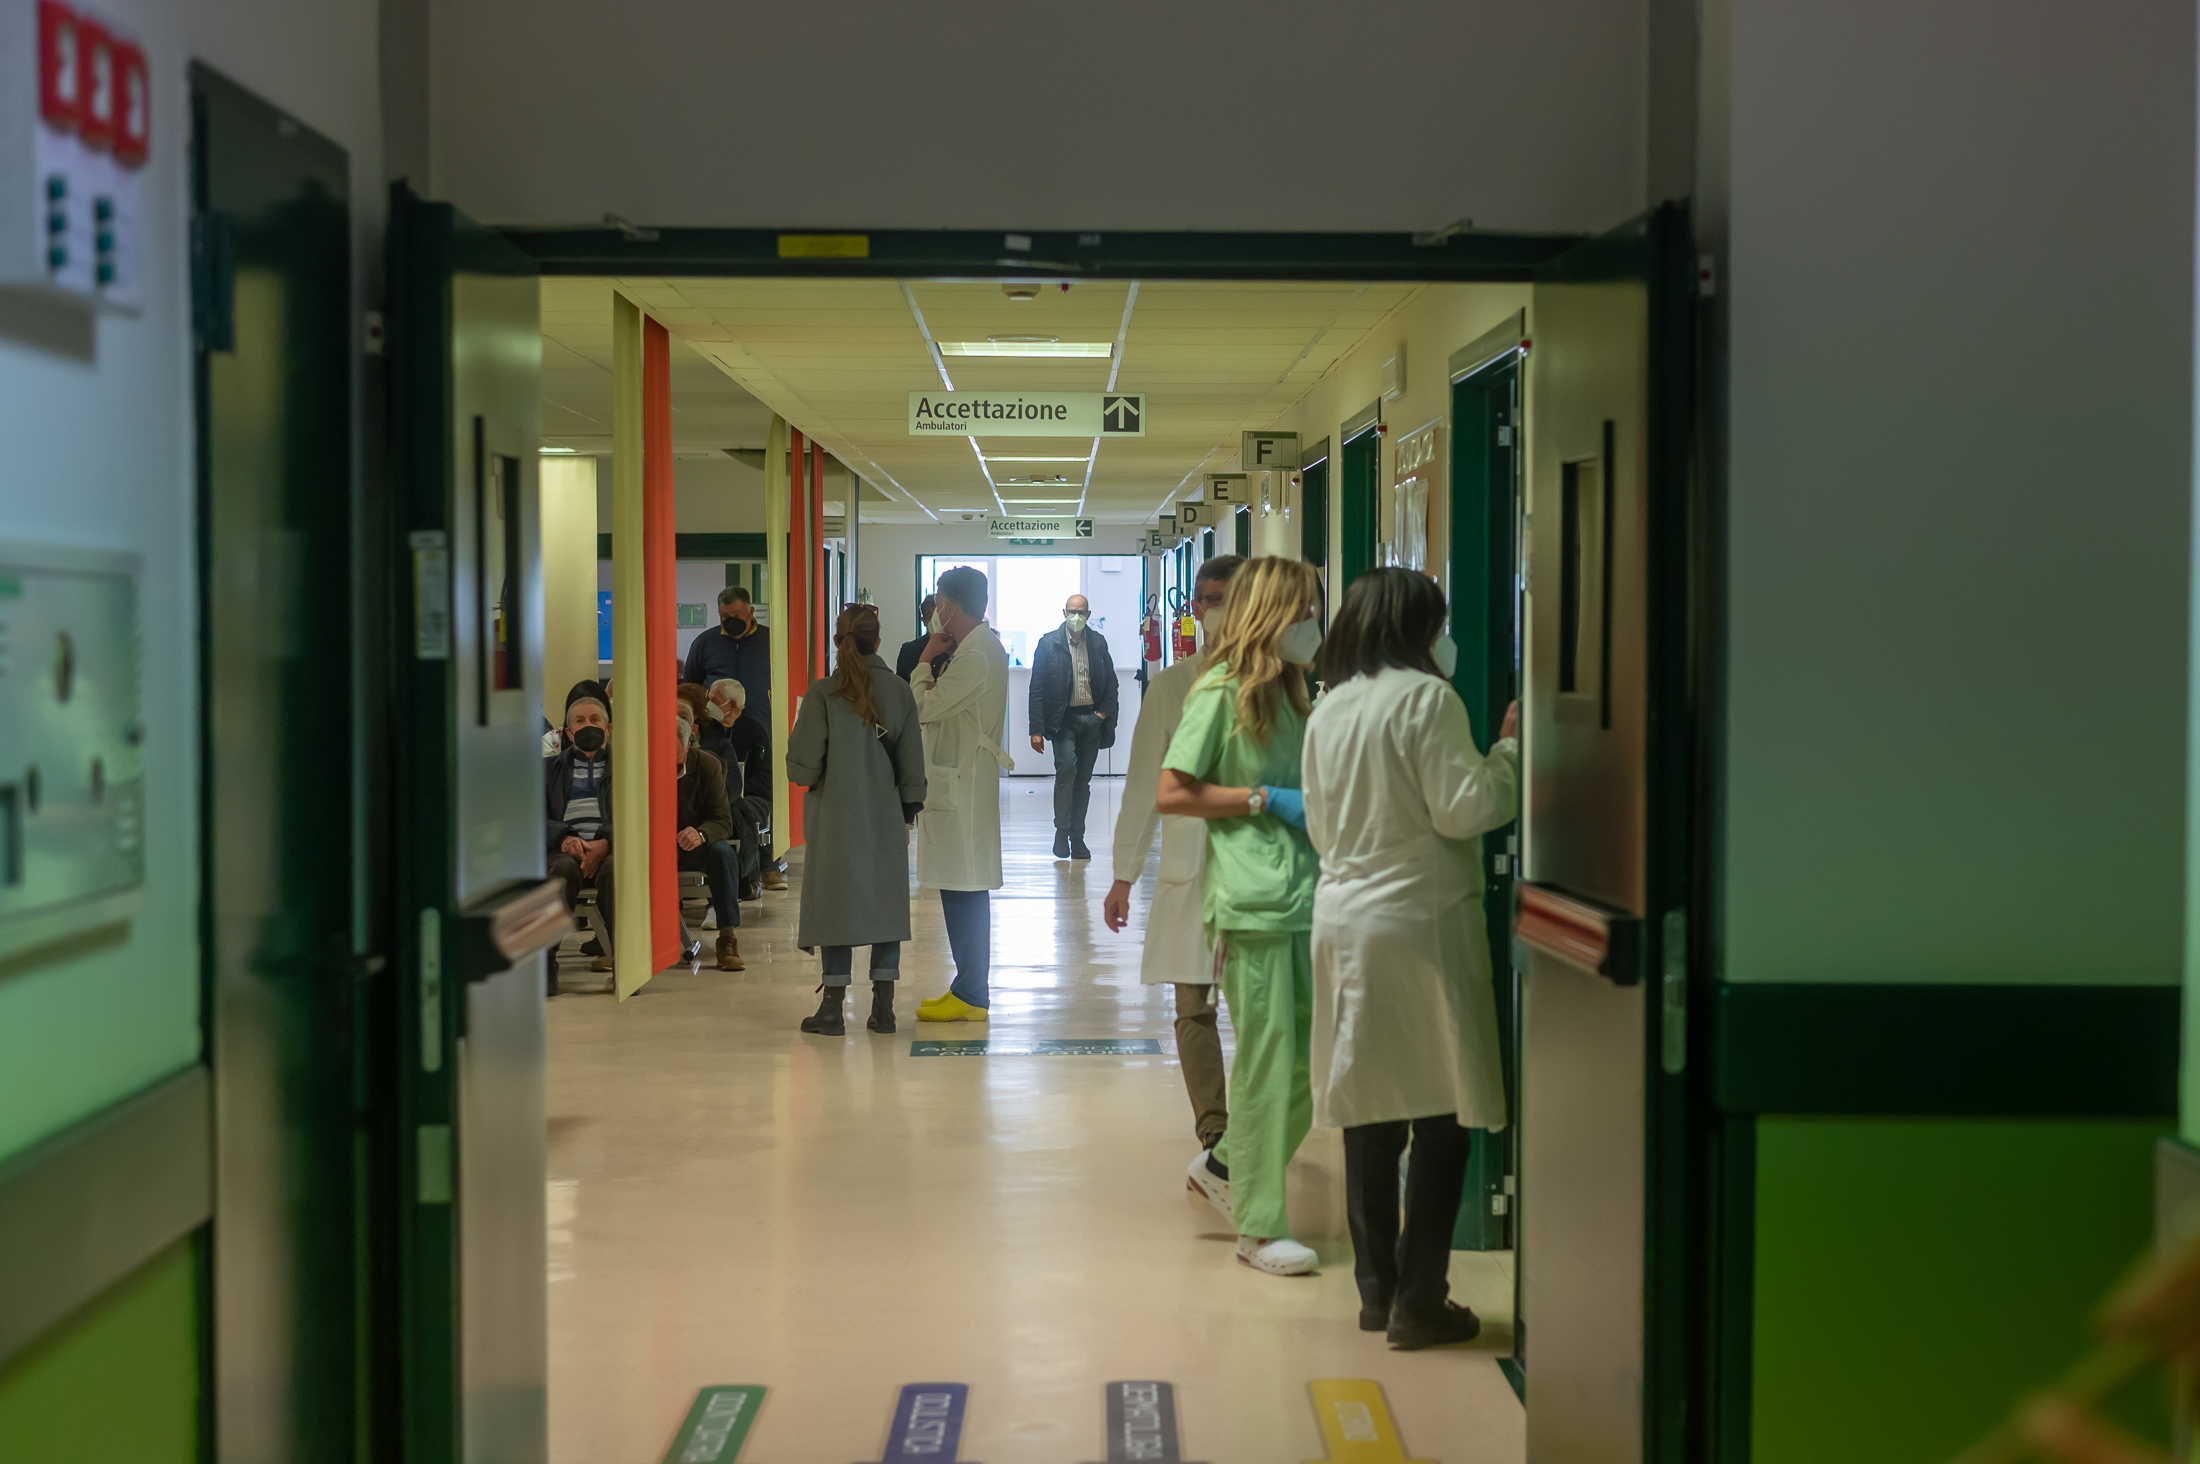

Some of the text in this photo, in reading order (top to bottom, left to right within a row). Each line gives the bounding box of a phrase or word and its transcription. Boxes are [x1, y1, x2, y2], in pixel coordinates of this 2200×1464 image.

[915, 397, 1067, 421] Accettazione
[915, 421, 967, 431] Ambulatori
[1257, 440, 1273, 464] F
[1214, 481, 1228, 500] E
[1183, 507, 1197, 523] D
[990, 520, 1060, 531] Accettazione
[1151, 534, 1162, 546] B
